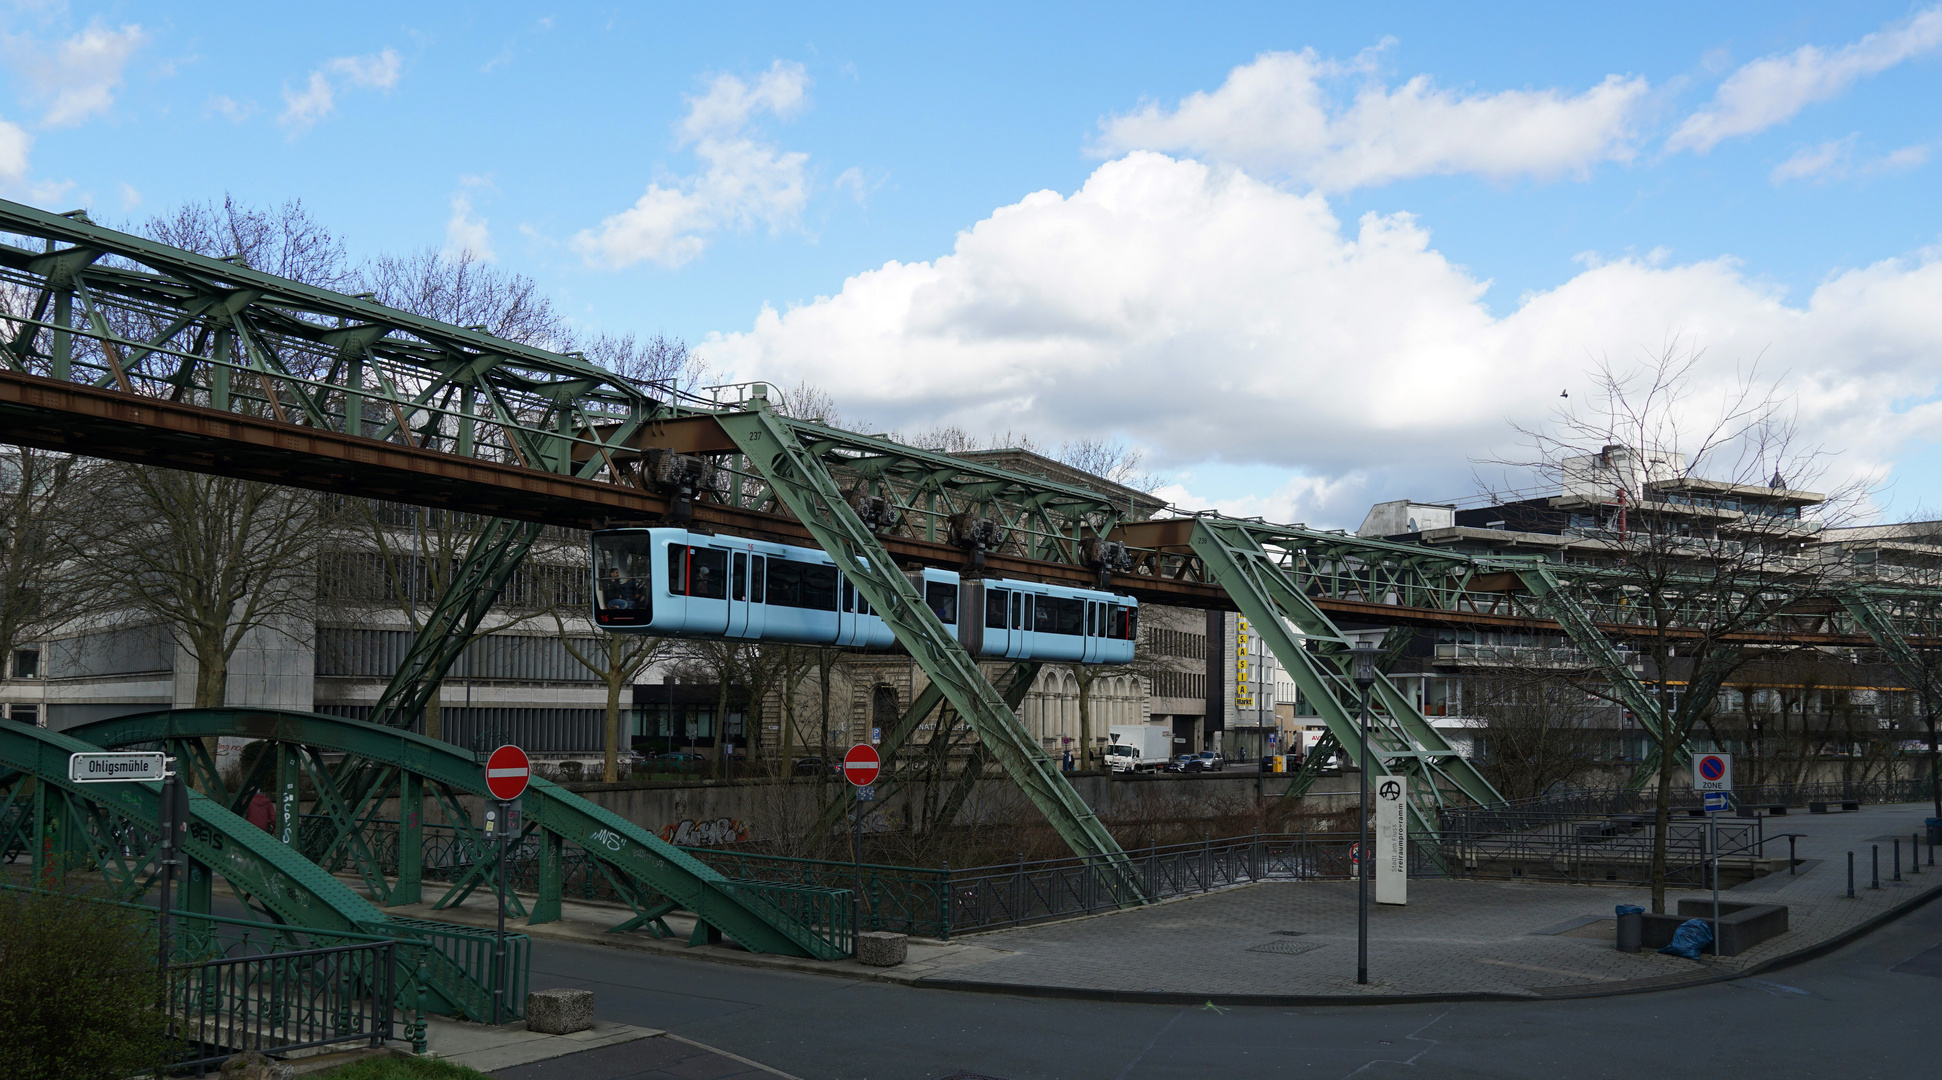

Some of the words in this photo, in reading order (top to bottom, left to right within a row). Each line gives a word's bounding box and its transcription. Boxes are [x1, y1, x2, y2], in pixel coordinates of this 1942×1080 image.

[749, 431, 762, 441] 237
[1236, 698, 1252, 706] Markt
[88, 759, 149, 776] Ohligsmühle
[1392, 842, 1397, 853] am
